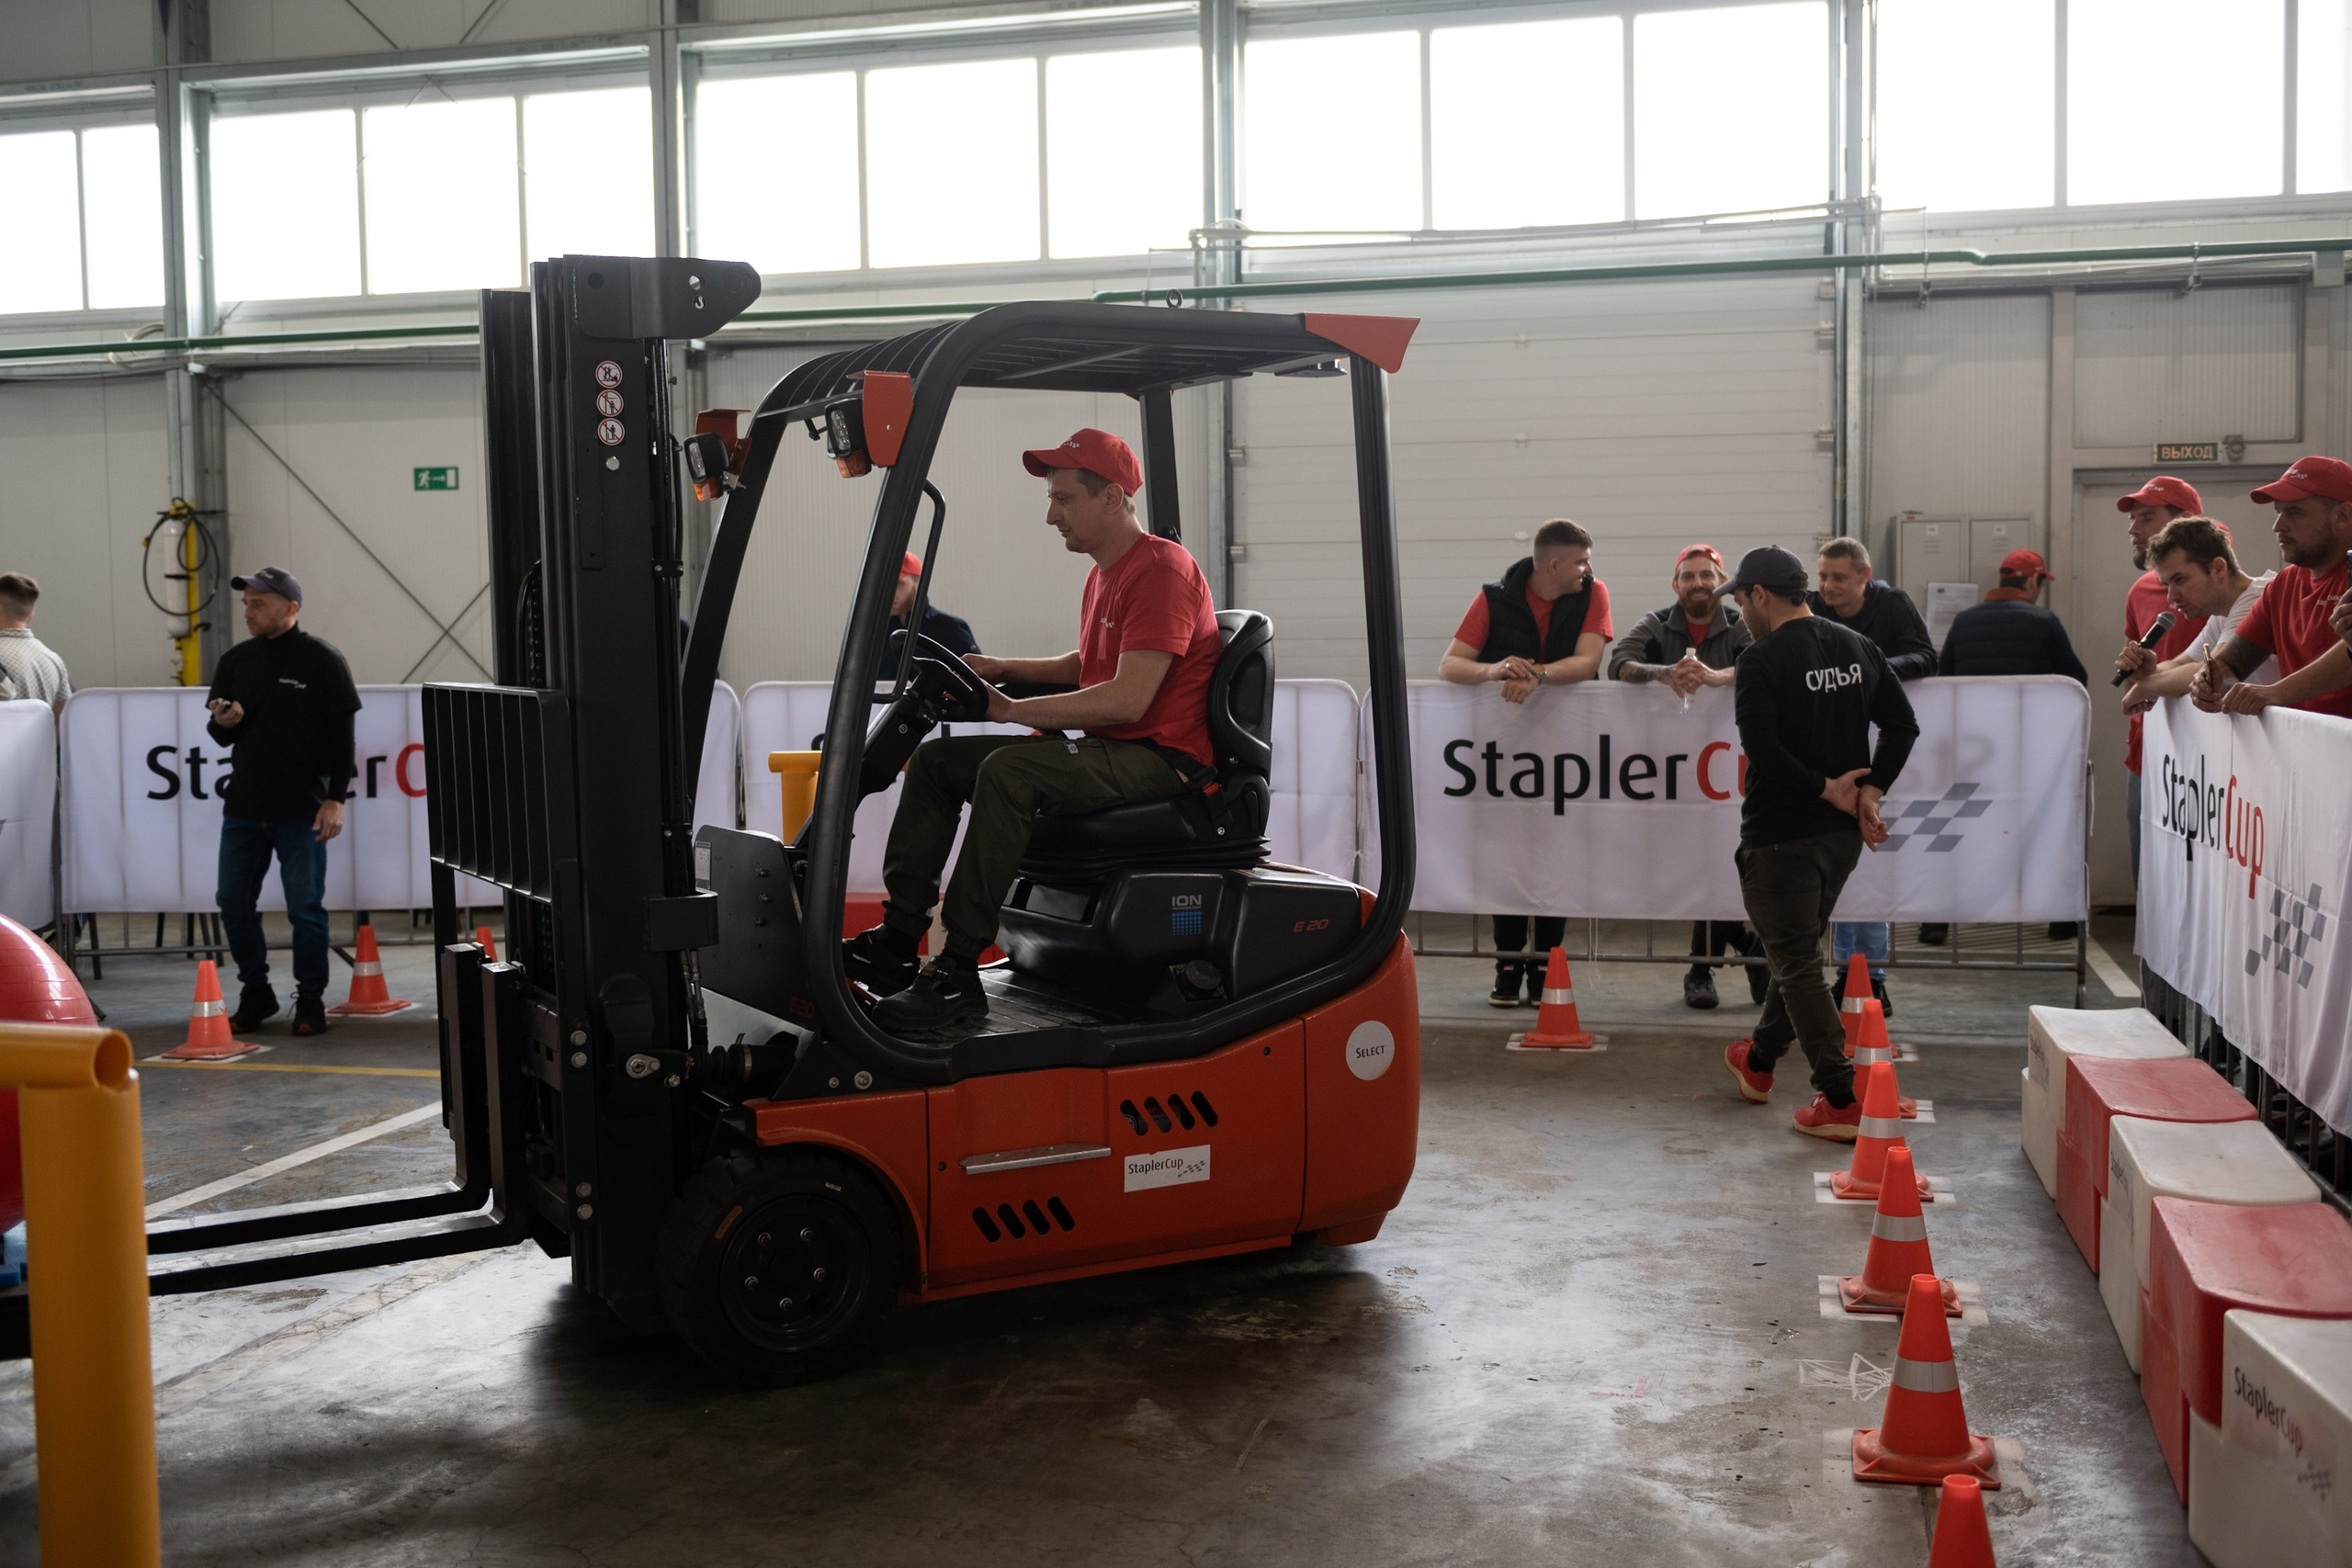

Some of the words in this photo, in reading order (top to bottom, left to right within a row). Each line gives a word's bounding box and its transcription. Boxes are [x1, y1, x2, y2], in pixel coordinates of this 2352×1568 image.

[2161, 446, 2213, 459] ВЫХОД
[1805, 663, 1862, 694] СУДЬЯ
[1443, 734, 1749, 816] StaplerC
[2162, 753, 2265, 900] StaplerCup
[1171, 894, 1202, 907] ION
[1128, 1158, 1183, 1175] StaplerCup
[2234, 1366, 2303, 1459] StaplerCup
